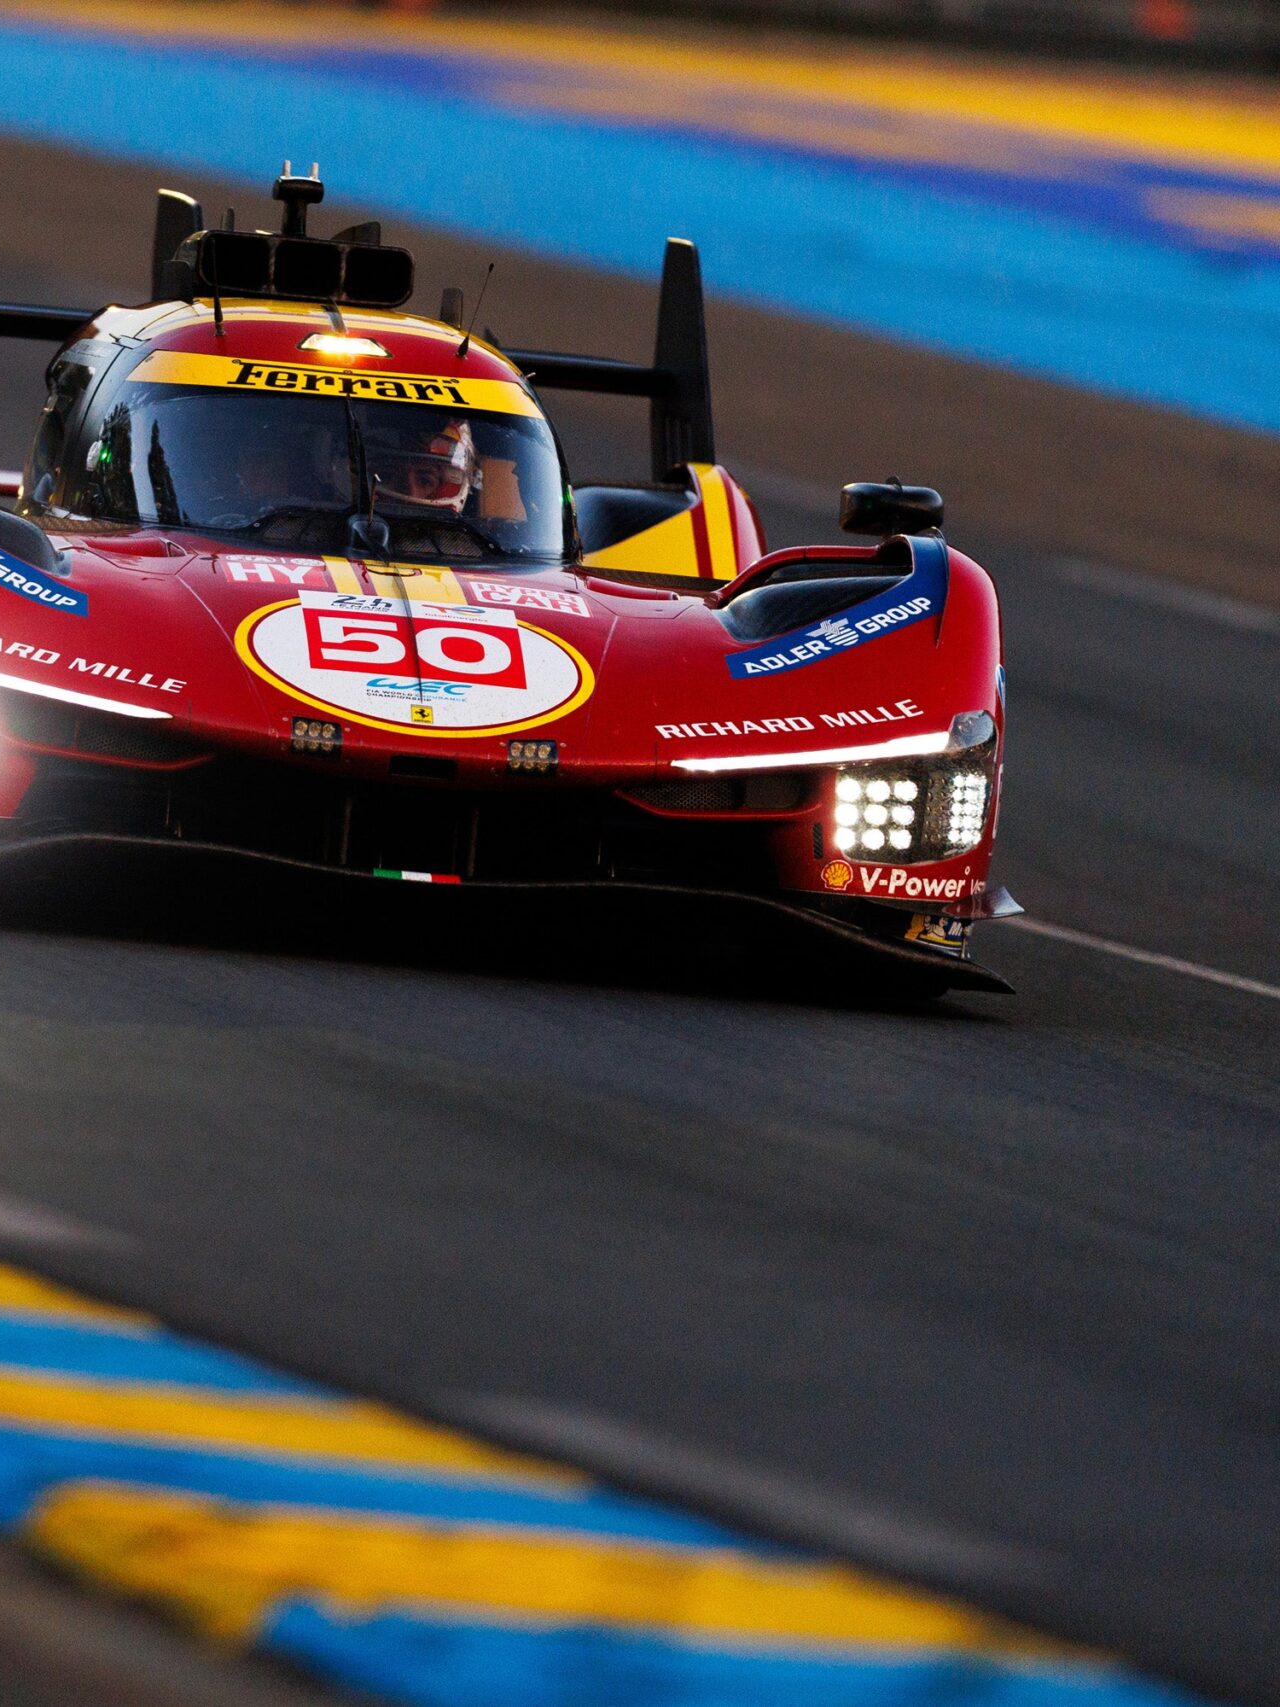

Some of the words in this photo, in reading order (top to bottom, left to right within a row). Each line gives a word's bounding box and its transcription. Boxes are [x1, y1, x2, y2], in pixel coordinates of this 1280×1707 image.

[227, 360, 470, 405] Ferrari
[227, 562, 313, 584] HY
[481, 591, 582, 614] CAR
[318, 616, 512, 675] 50
[743, 639, 832, 674] ADLER
[855, 597, 931, 634] GROUP
[68, 657, 187, 693] MILLE
[366, 678, 473, 695] WEC
[655, 716, 815, 739] RICHARD
[820, 699, 924, 728] MILLE
[859, 866, 967, 898] V-Power
